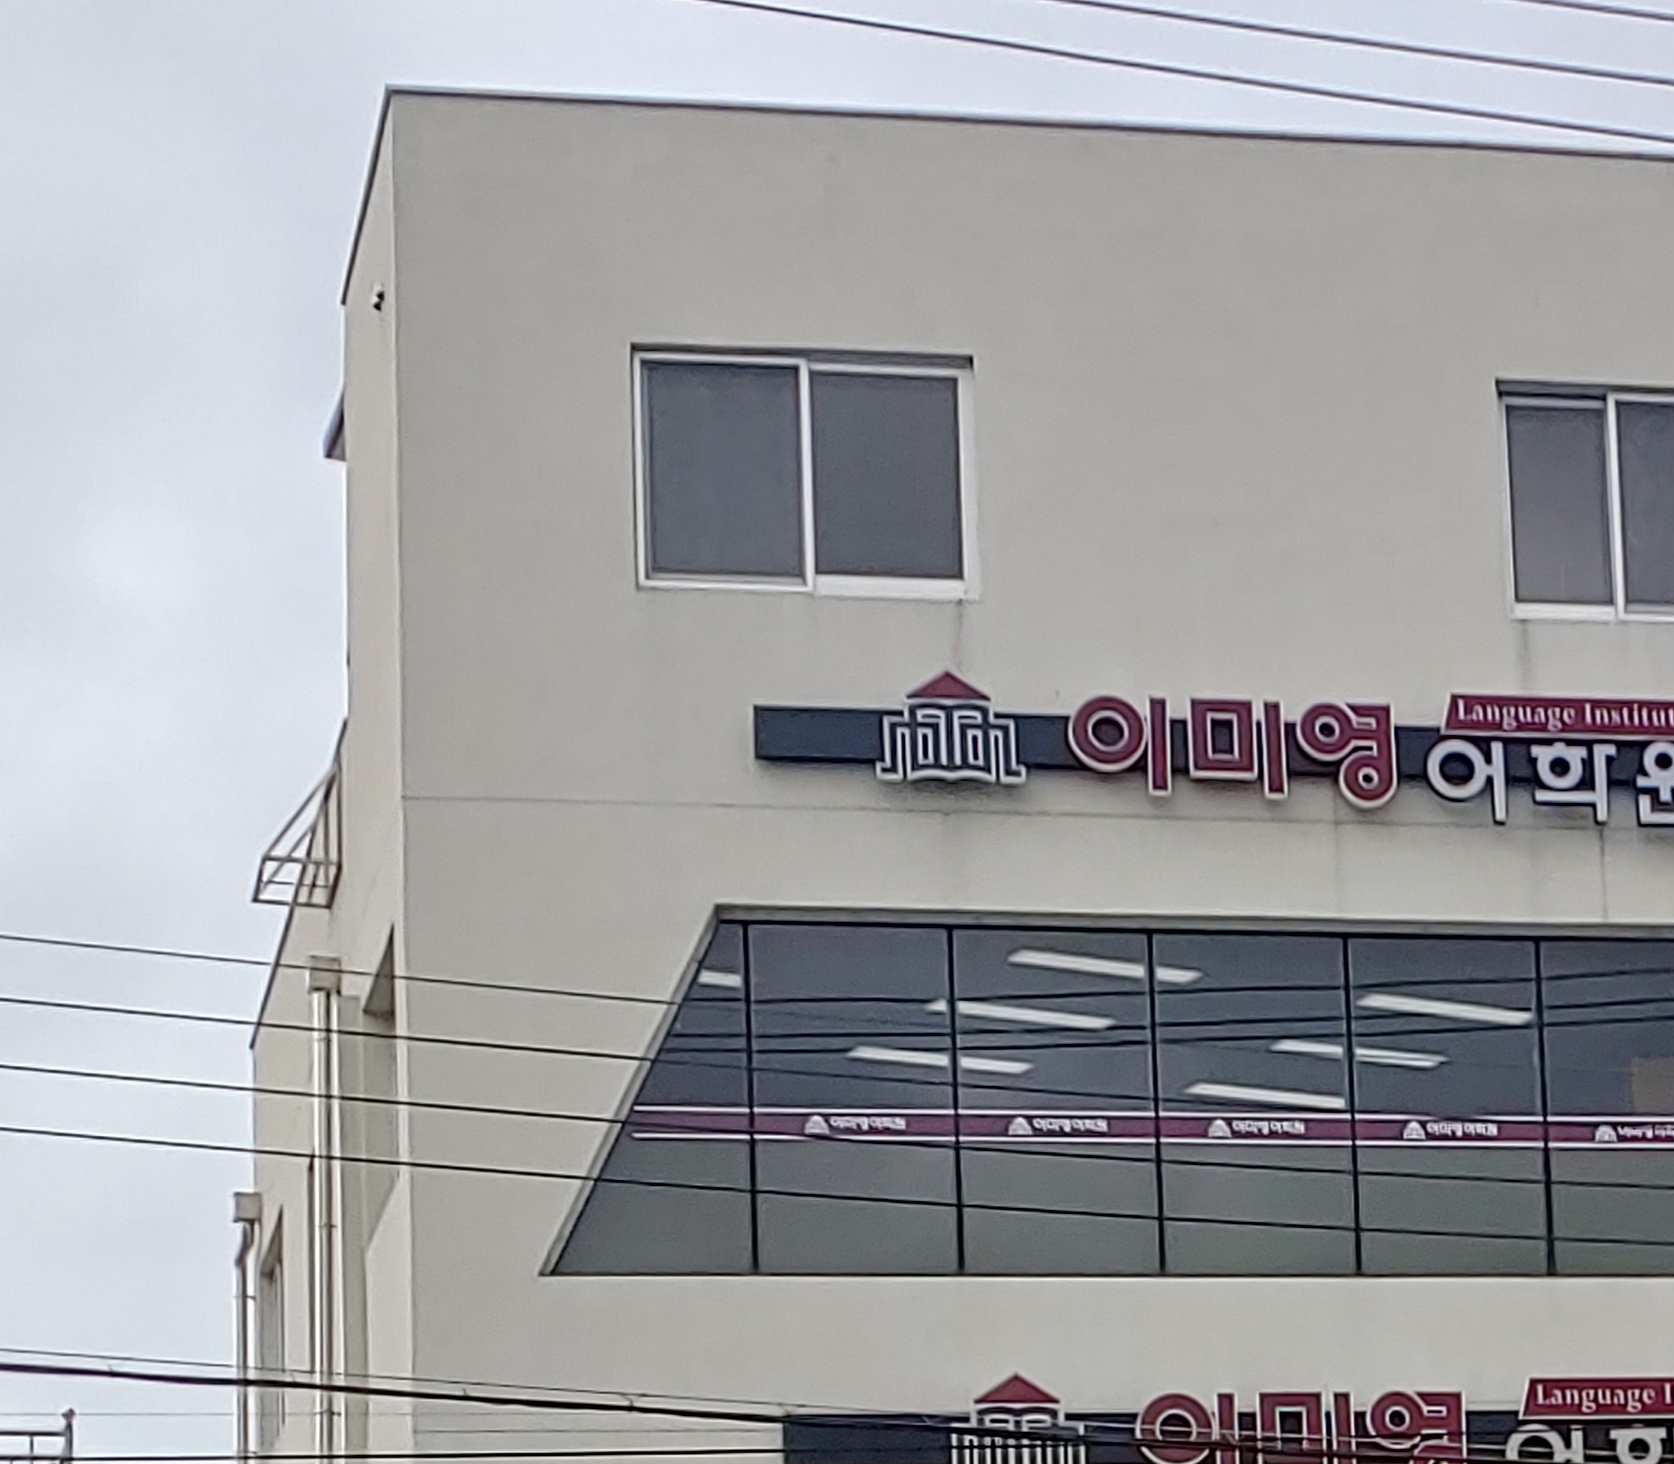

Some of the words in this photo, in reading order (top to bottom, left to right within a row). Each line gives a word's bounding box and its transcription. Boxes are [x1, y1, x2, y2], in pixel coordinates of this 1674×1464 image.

[1457, 698, 1576, 731] Language
[1068, 694, 1396, 811] 이미영
[1536, 1383, 1656, 1413] Language
